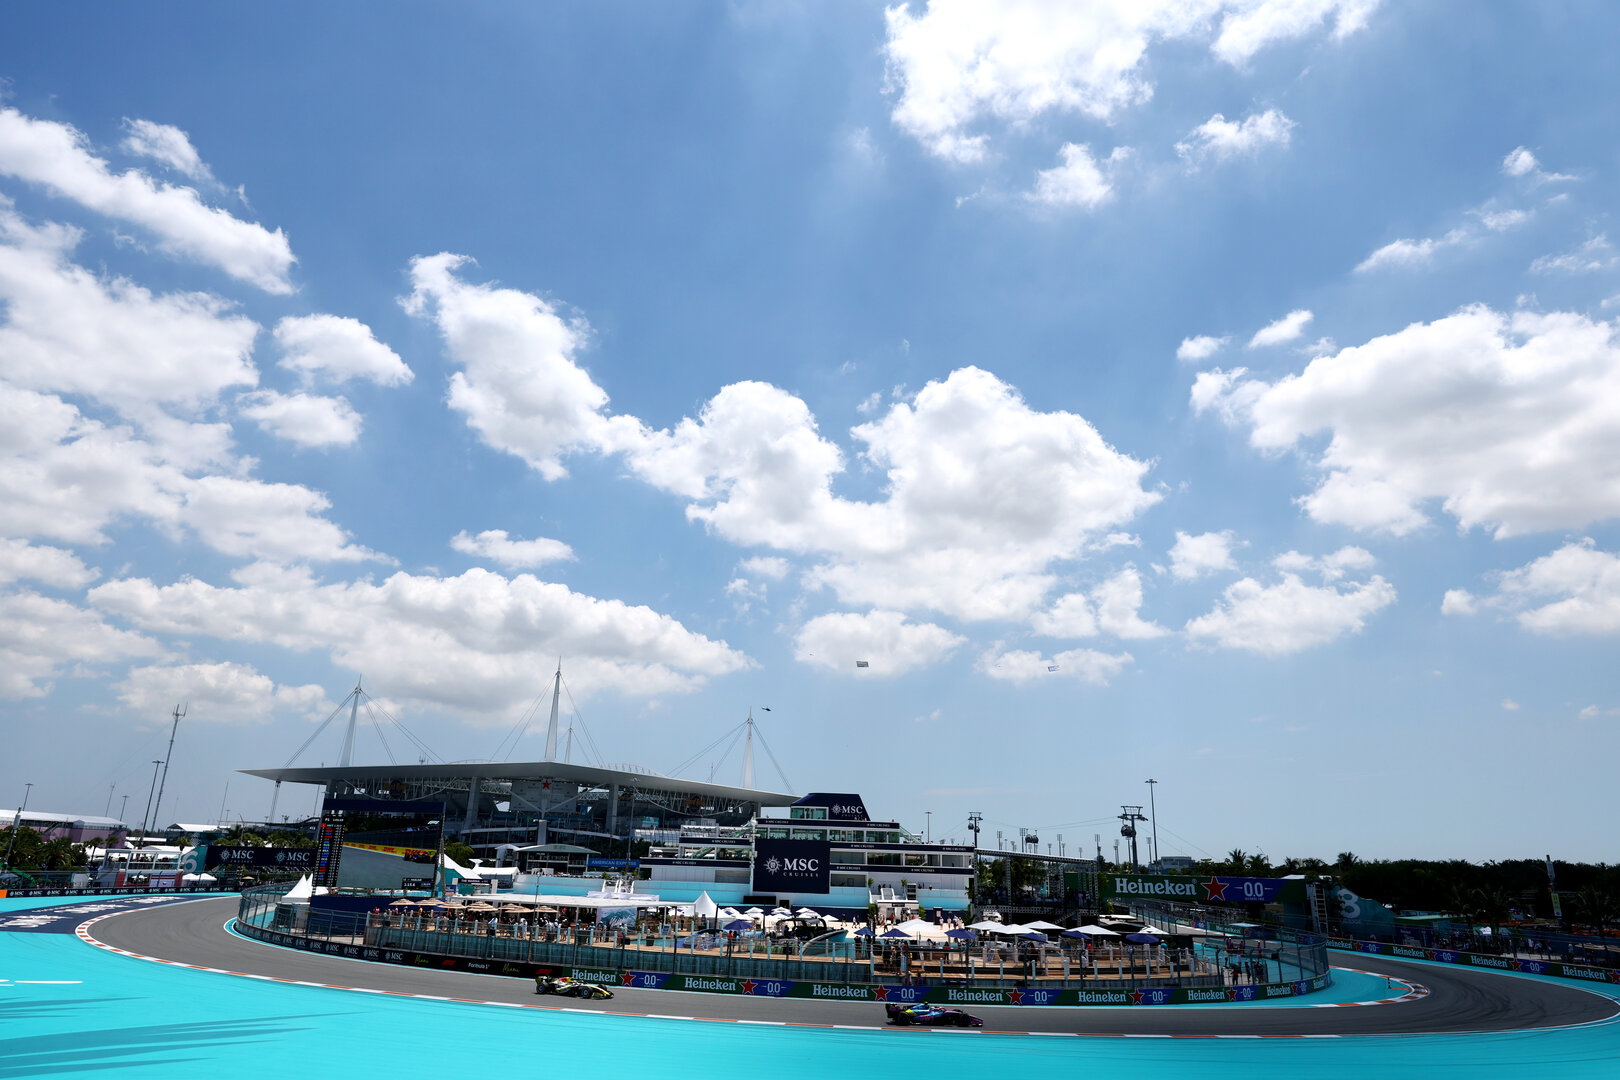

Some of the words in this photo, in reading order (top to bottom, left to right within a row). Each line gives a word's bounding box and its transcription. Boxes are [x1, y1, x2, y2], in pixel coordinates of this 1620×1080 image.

[842, 806, 862, 814] MSC
[231, 850, 254, 859] MSC
[287, 852, 310, 861] MSC
[182, 850, 198, 873] 6
[783, 858, 818, 871] MSC
[1114, 878, 1196, 895] Heineken
[1243, 881, 1264, 897] 0.0
[1337, 888, 1360, 918] 8
[368, 949, 379, 957] MSC
[391, 952, 403, 960] MSC
[1393, 946, 1424, 957] Heineken
[1471, 956, 1508, 968] Heineken
[502, 963, 520, 973] Miami
[1563, 966, 1606, 980] Heineken
[572, 969, 616, 982] Heineken
[685, 977, 736, 991] Heineken
[813, 984, 868, 997] Heineken
[948, 989, 1003, 1001] Heineken
[1188, 990, 1225, 1000] Heineken
[1267, 985, 1291, 996] Heineken
[1078, 991, 1126, 1002] Heineken
